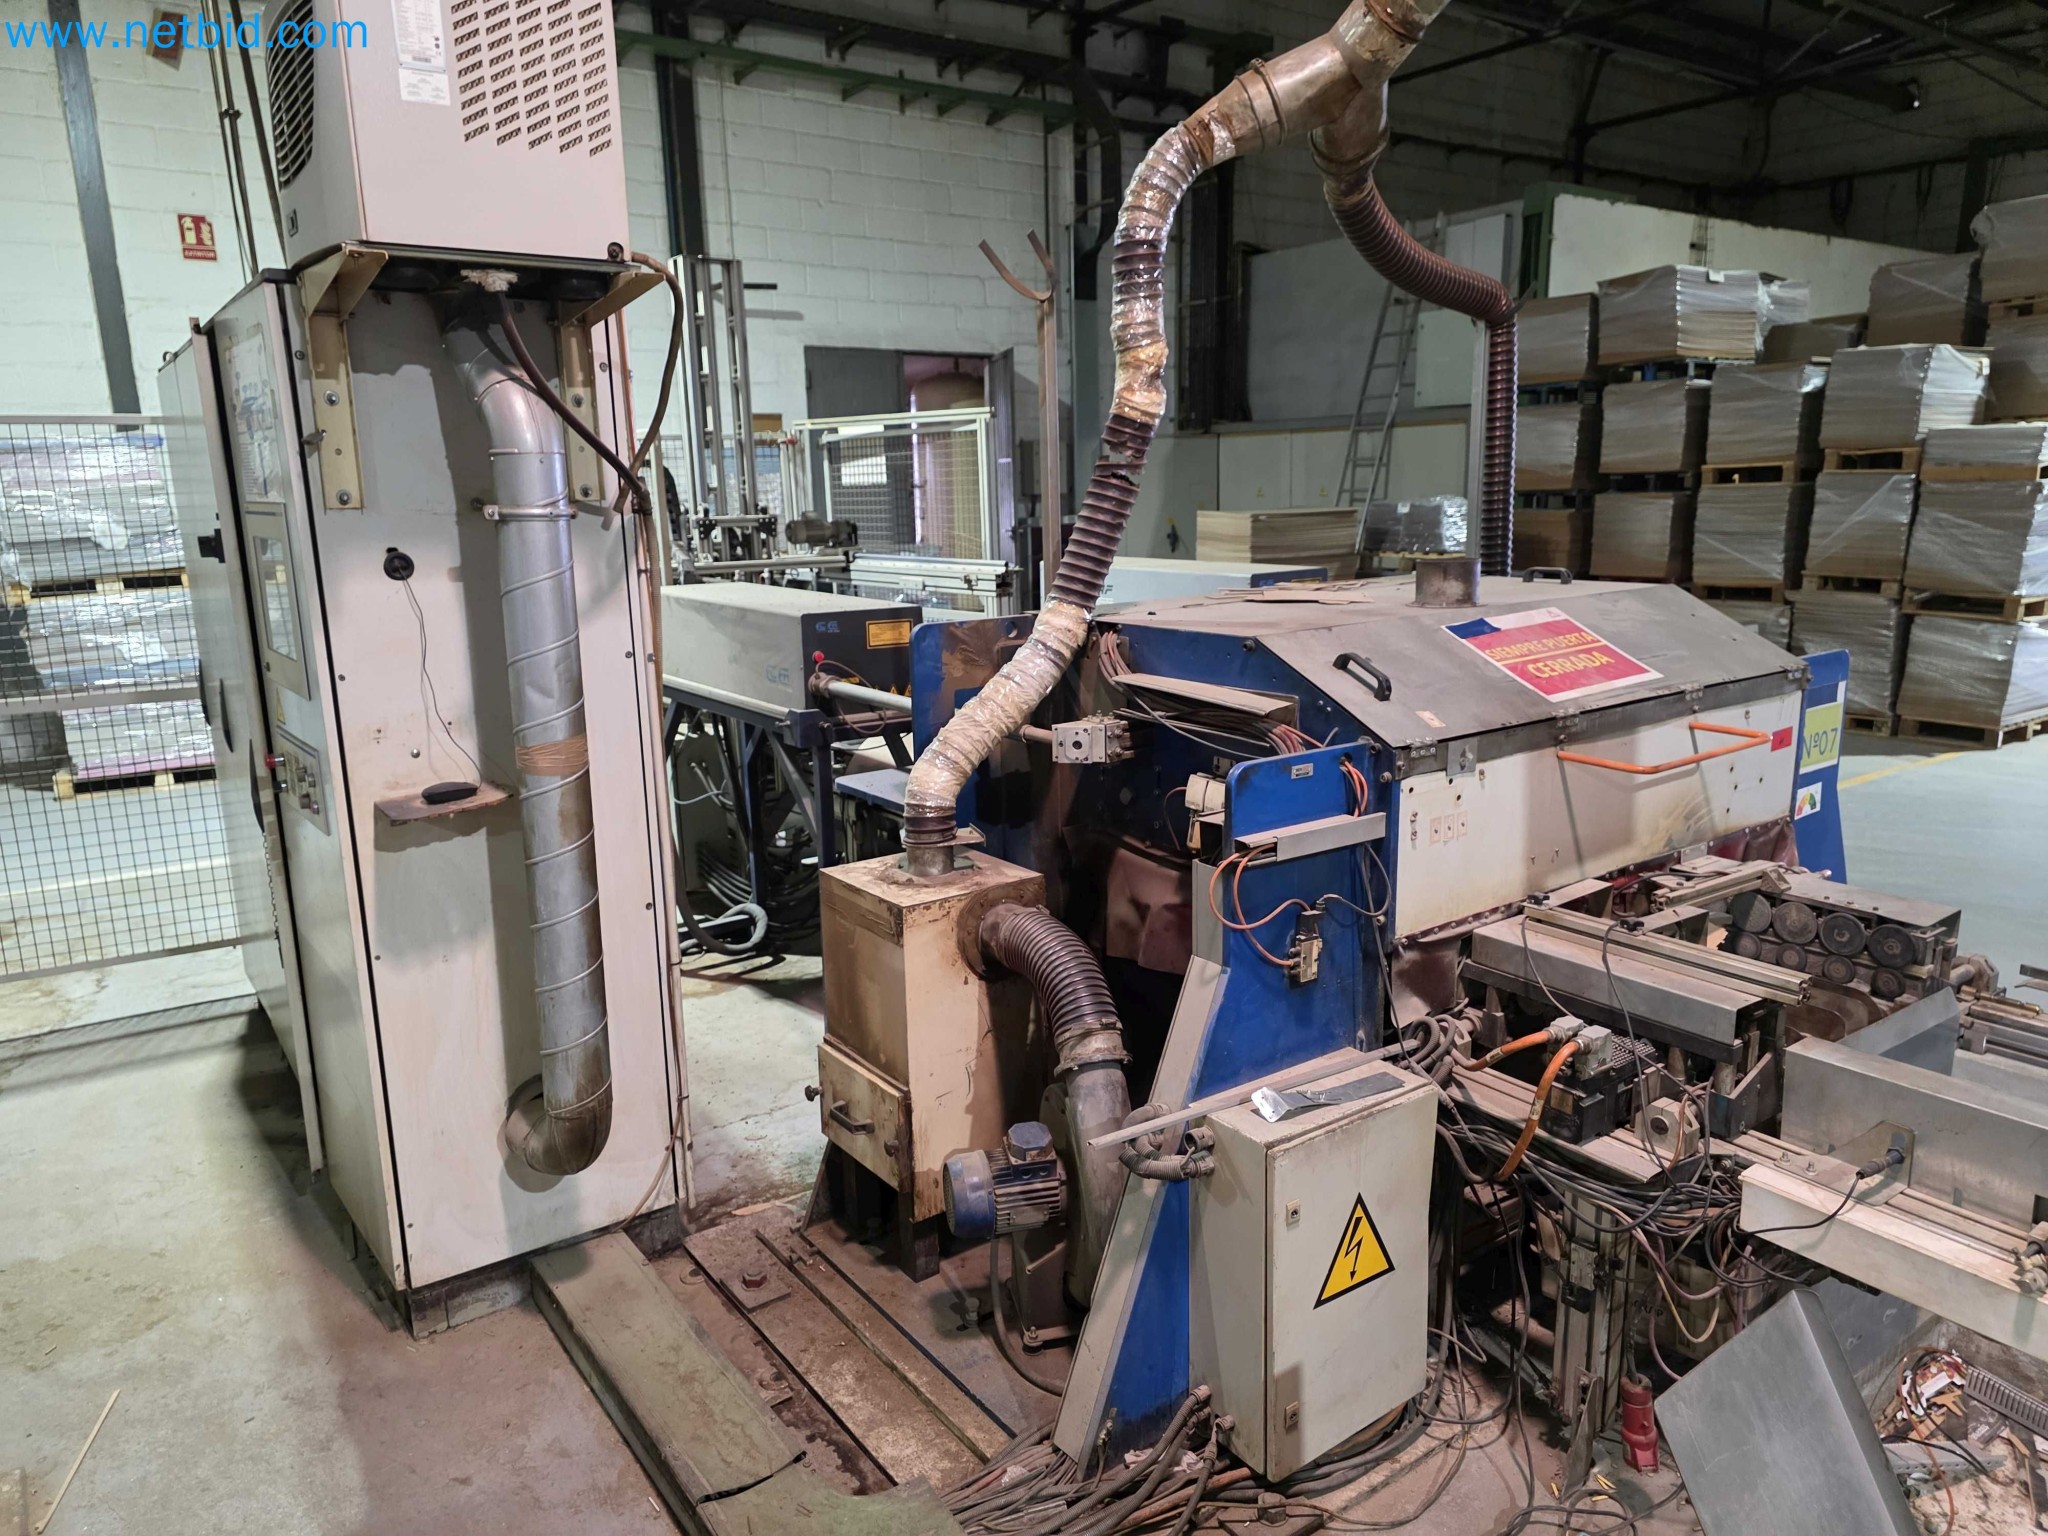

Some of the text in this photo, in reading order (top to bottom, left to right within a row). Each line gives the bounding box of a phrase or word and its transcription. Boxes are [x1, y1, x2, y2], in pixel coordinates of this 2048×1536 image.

[1484, 632, 1598, 661] SIEMPRE PUERTA
[1526, 651, 1615, 679] CERRADA
